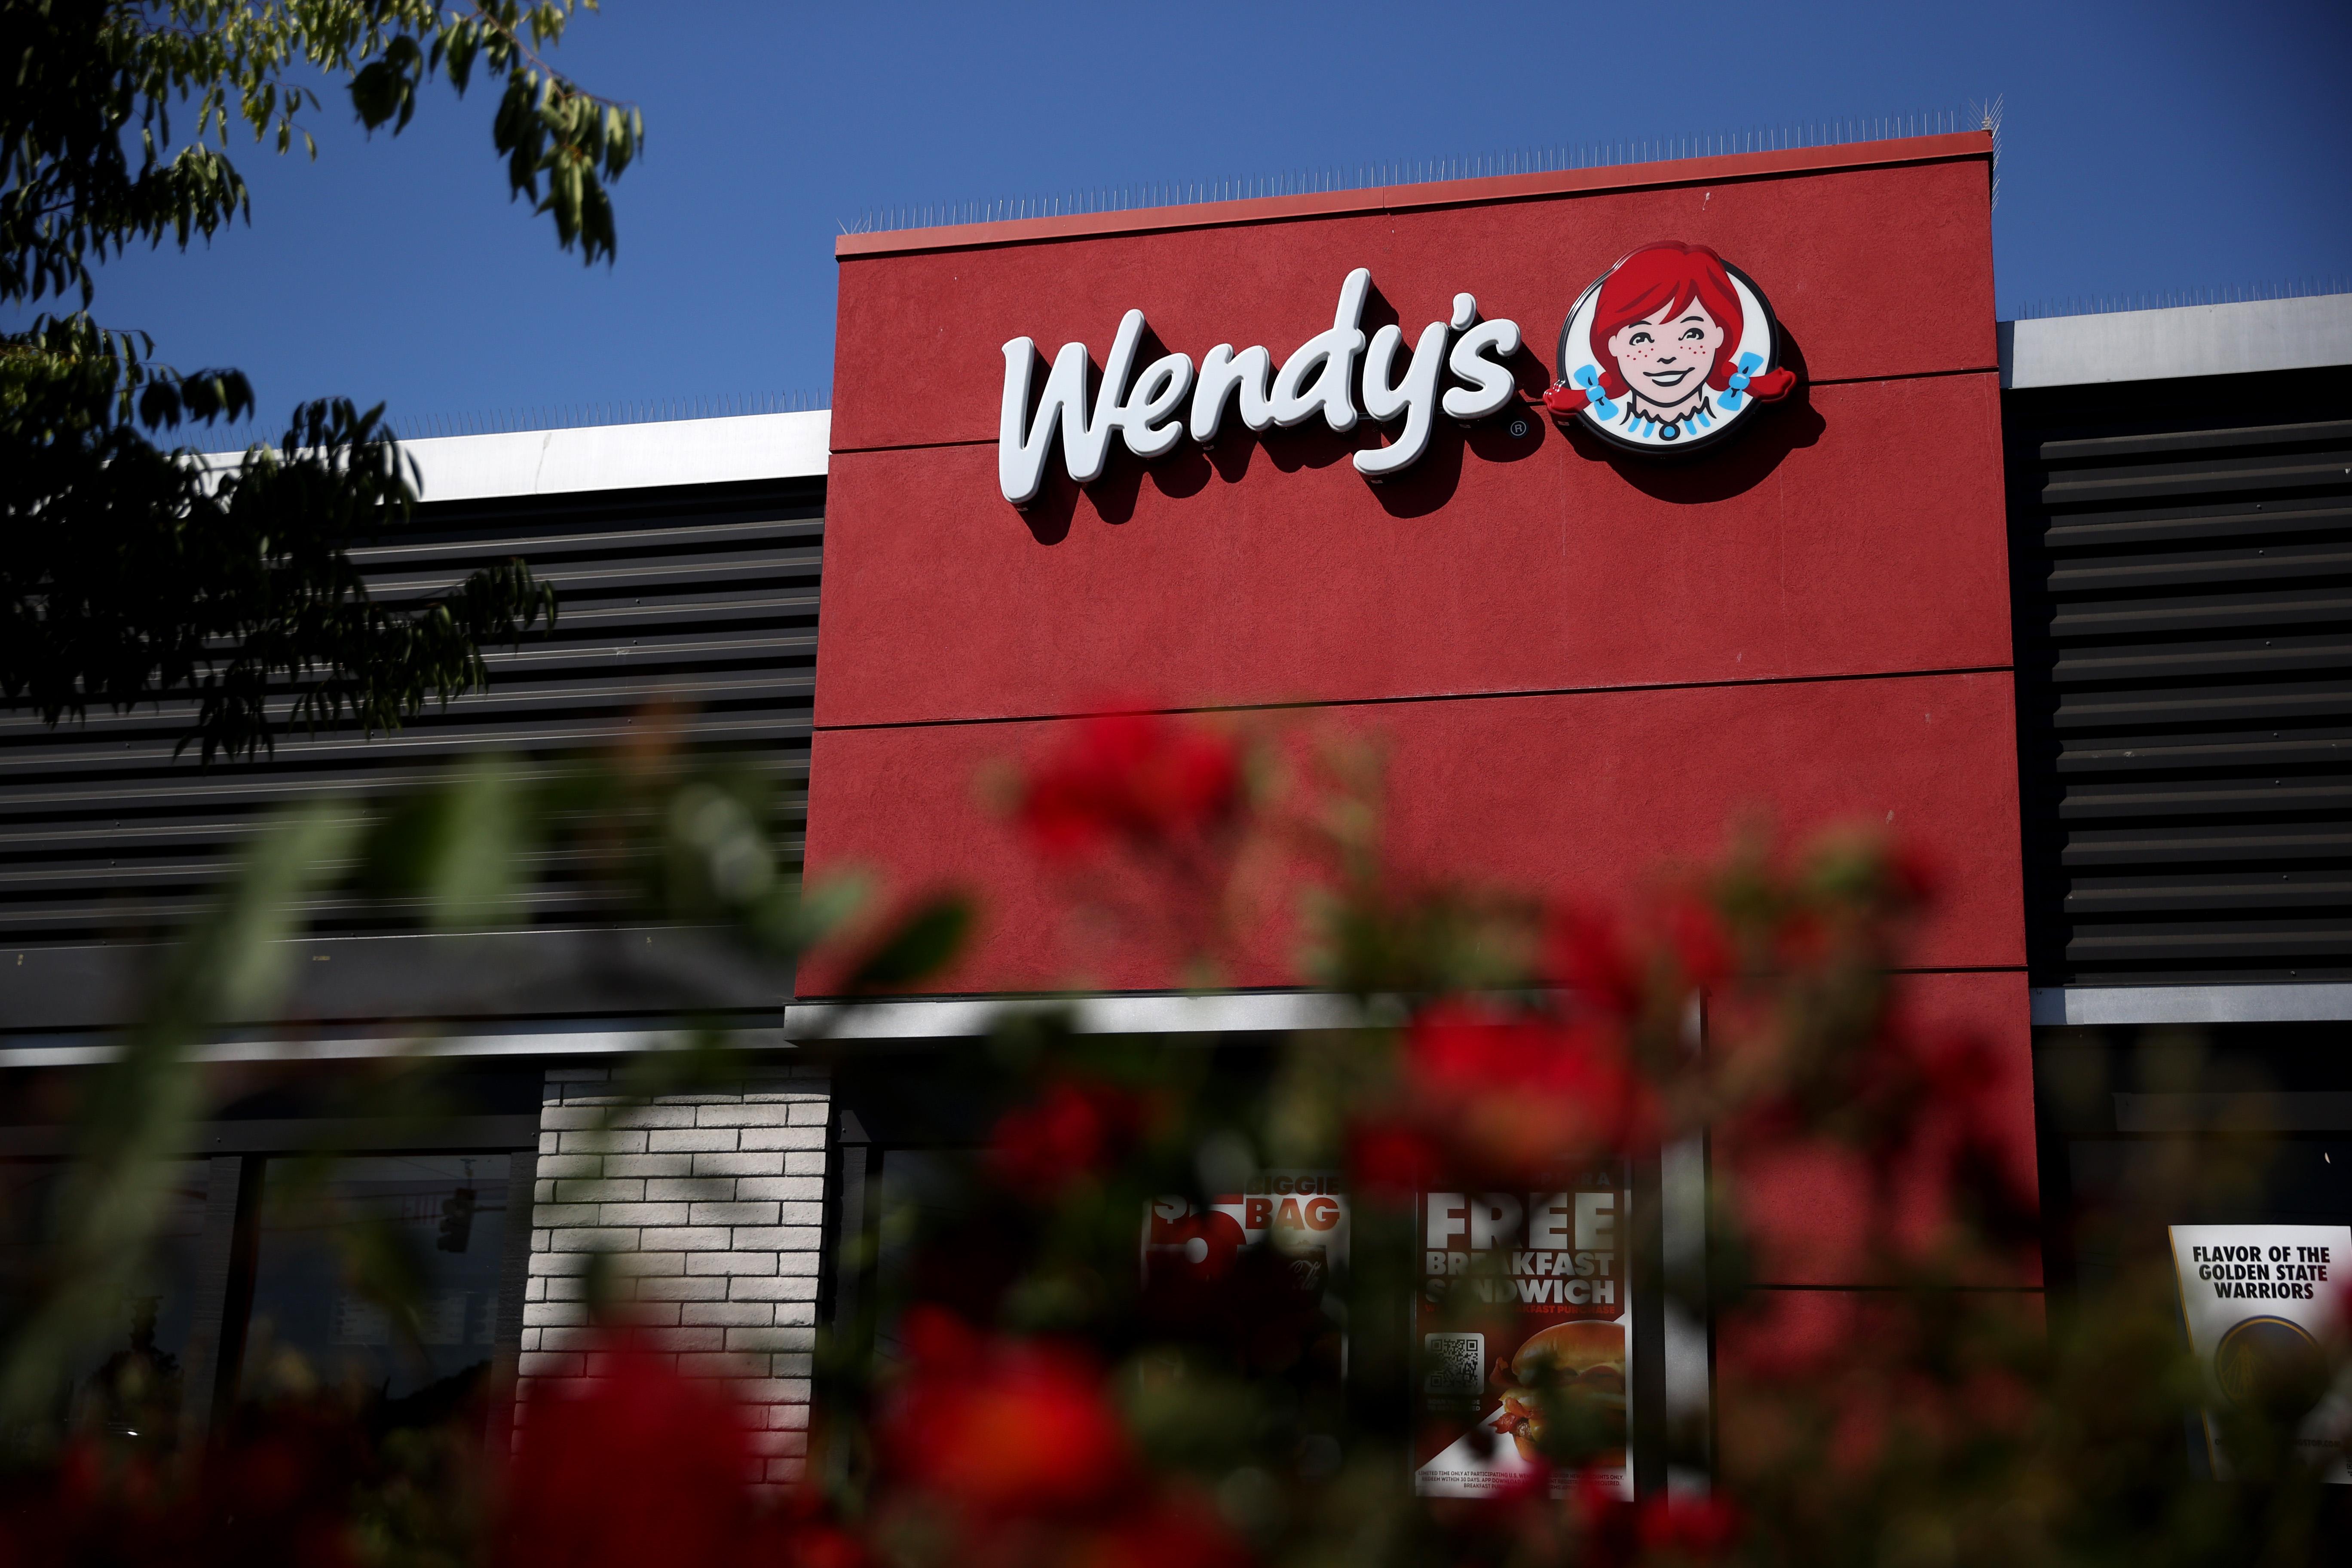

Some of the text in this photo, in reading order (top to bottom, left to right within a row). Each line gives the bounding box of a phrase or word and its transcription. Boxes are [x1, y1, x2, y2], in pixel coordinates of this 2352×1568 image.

[998, 267, 1522, 504] Wendy's
[1246, 1176, 1340, 1196] BIGGIE
[1246, 1197, 1340, 1231] BAG
[1427, 1192, 1614, 1250] FREE
[2193, 1246, 2331, 1263] FLAVOR OF THE
[2199, 1264, 2328, 1281] GOLDEN STATE
[2214, 1282, 2314, 1299] WARRIORS
[1500, 1305, 1555, 1314] AKFAST
